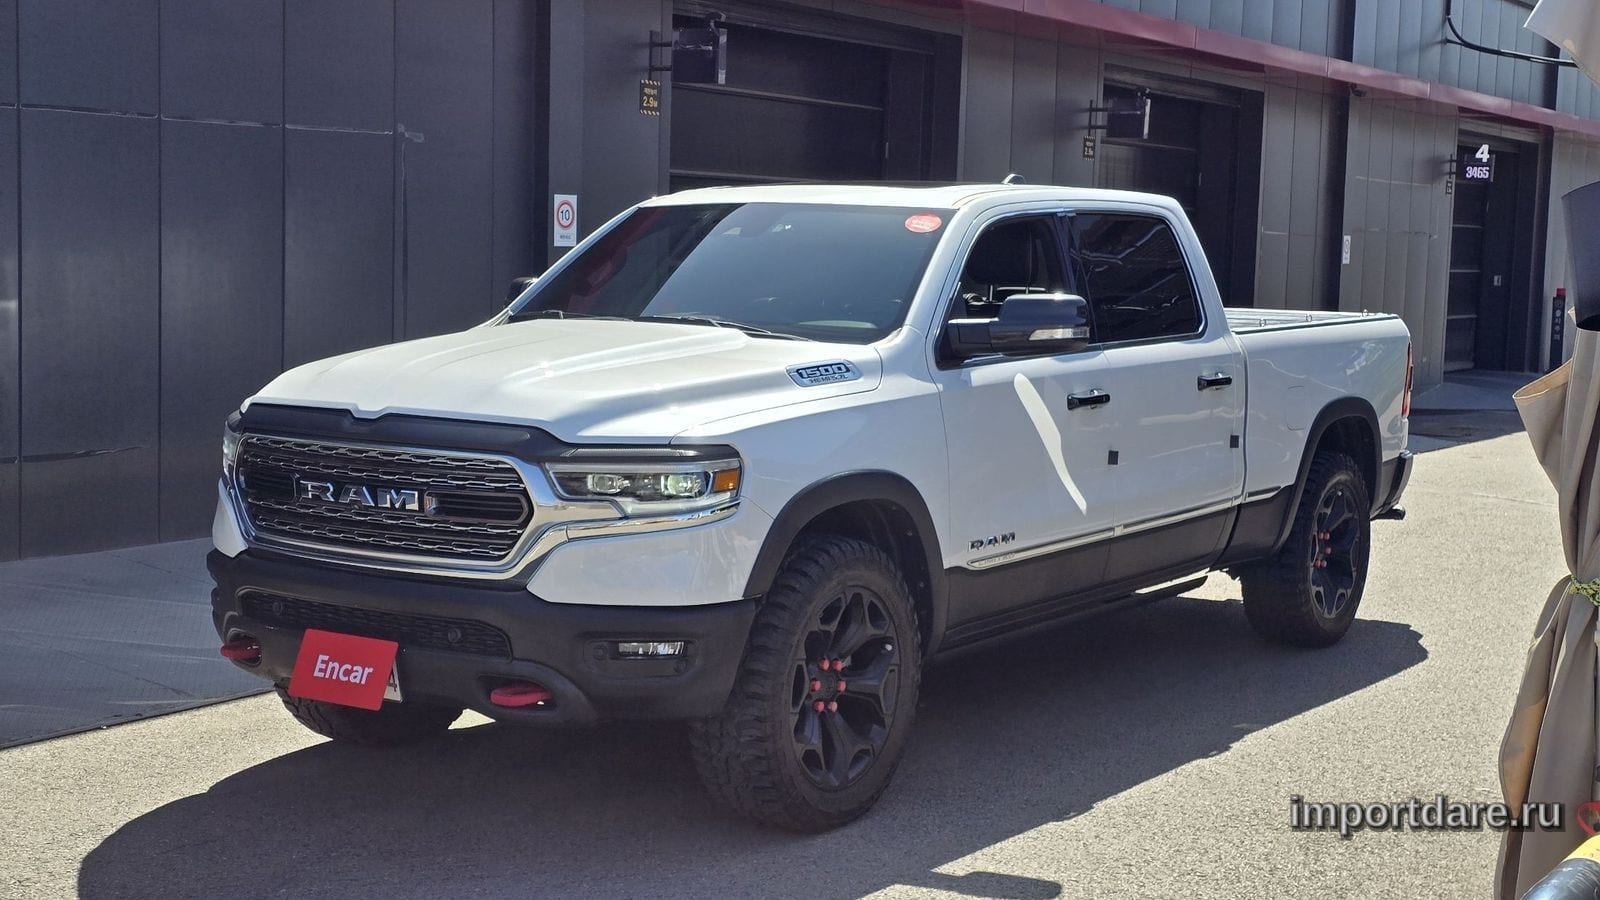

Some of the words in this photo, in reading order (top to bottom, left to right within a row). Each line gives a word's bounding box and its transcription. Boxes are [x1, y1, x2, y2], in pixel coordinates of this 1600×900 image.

[1475, 143, 1490, 163] 4
[1465, 165, 1490, 179] 3465
[560, 209, 571, 221] 10
[797, 363, 847, 378] 1500
[299, 480, 420, 511] RAM
[968, 531, 1016, 552] RAM
[313, 654, 374, 685] Encar
